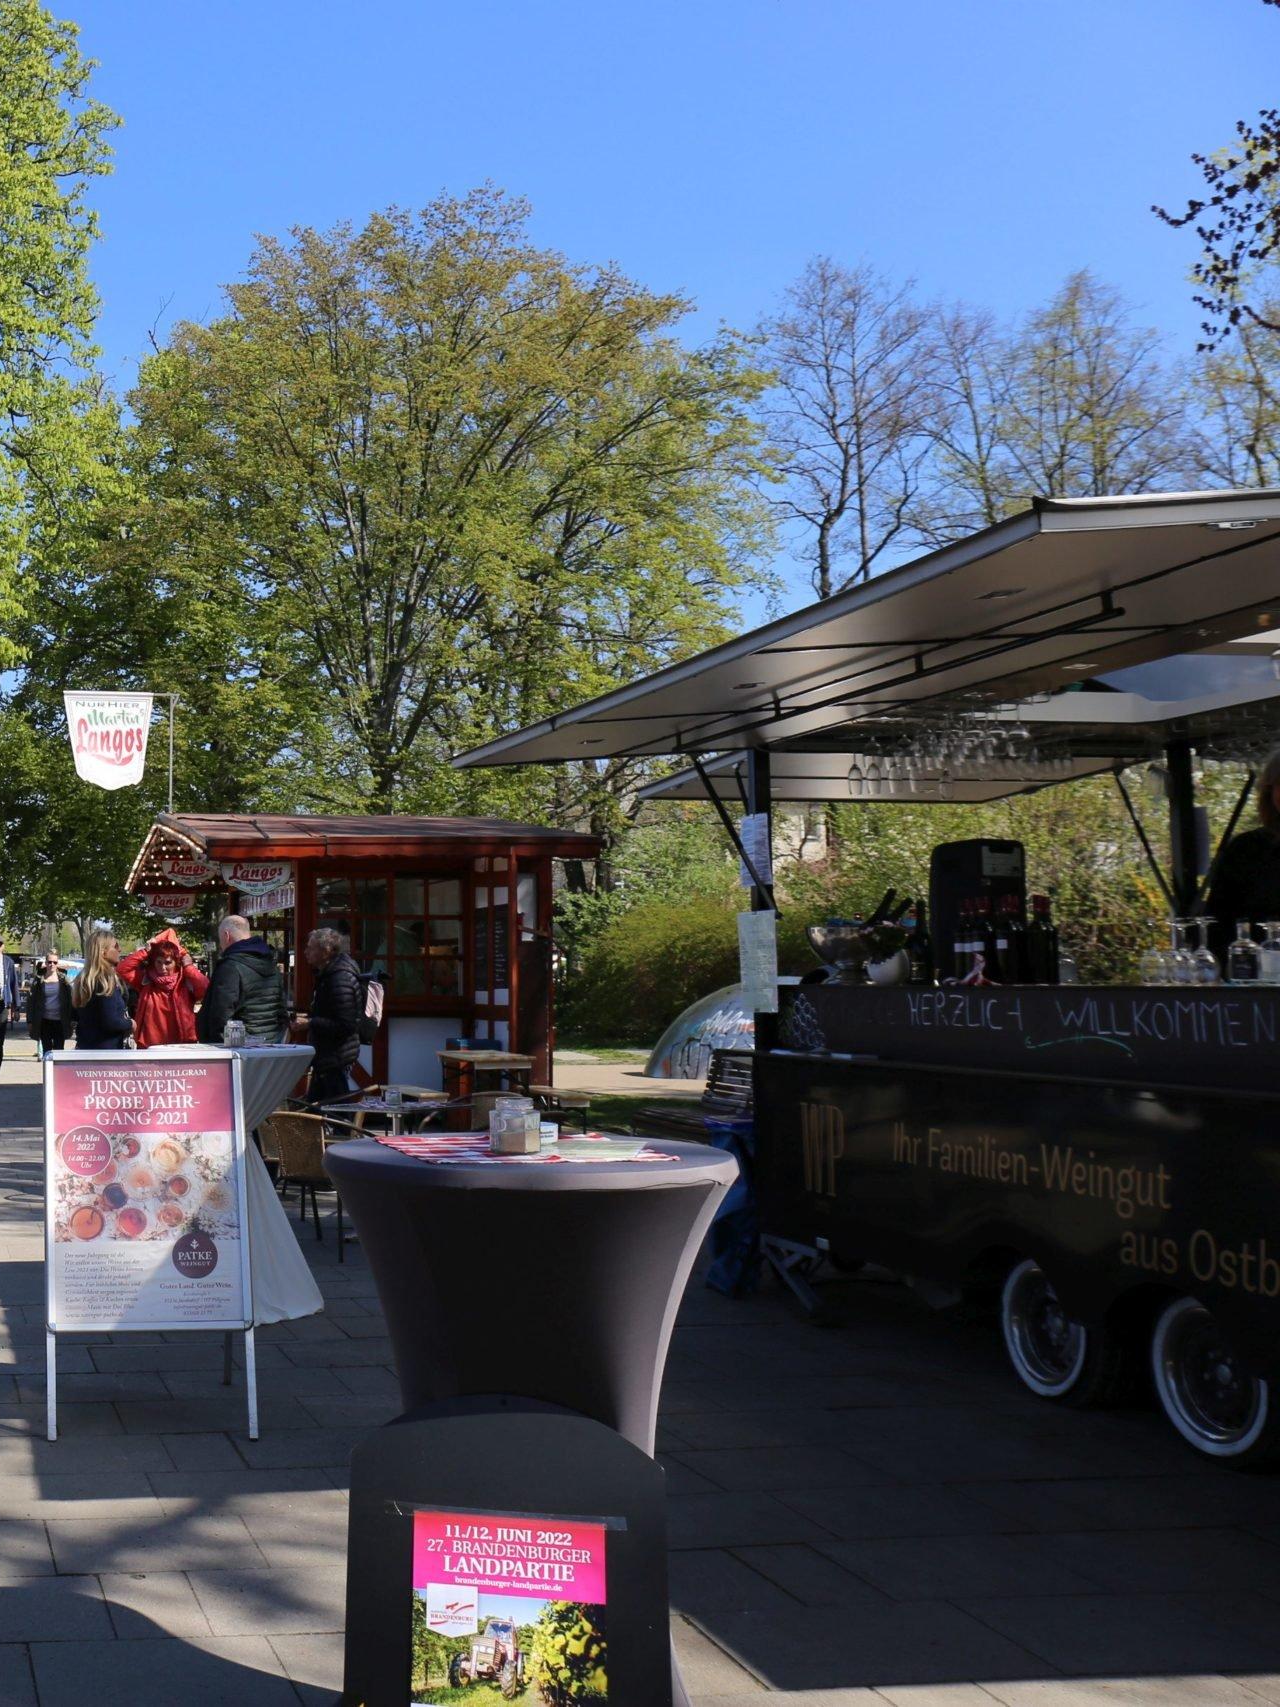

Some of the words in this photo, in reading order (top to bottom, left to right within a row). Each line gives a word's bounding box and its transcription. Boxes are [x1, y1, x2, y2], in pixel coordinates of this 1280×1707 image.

[229, 863, 283, 881] Langos
[1055, 997, 1276, 1046] WILLKOMMEN
[76, 1070, 152, 1078] WEINVERKOSTUNG
[165, 1069, 207, 1077] PILLGRAM
[90, 1079, 193, 1096] JUNGWEIN-
[83, 1095, 145, 1110] PROBE
[147, 1095, 201, 1112] JAHR-
[96, 1112, 151, 1125] GANG
[156, 1112, 189, 1125] 2021
[84, 1134, 100, 1142] Mai
[76, 1143, 96, 1151] 2022
[892, 1121, 922, 1166] Ihr
[927, 1127, 1173, 1219] Familien-Weingut
[178, 1251, 212, 1261] PATKE
[1119, 1230, 1179, 1276] aus
[445, 1524, 493, 1540] 11./12.
[496, 1527, 532, 1543] JUNI
[536, 1530, 572, 1546] 2022
[427, 1538, 447, 1553] 27.
[452, 1540, 592, 1564] BRANDENBURGER
[443, 1555, 575, 1582] LANDPARTIE
[454, 1576, 564, 1592] brandenburger-landpartie.de
